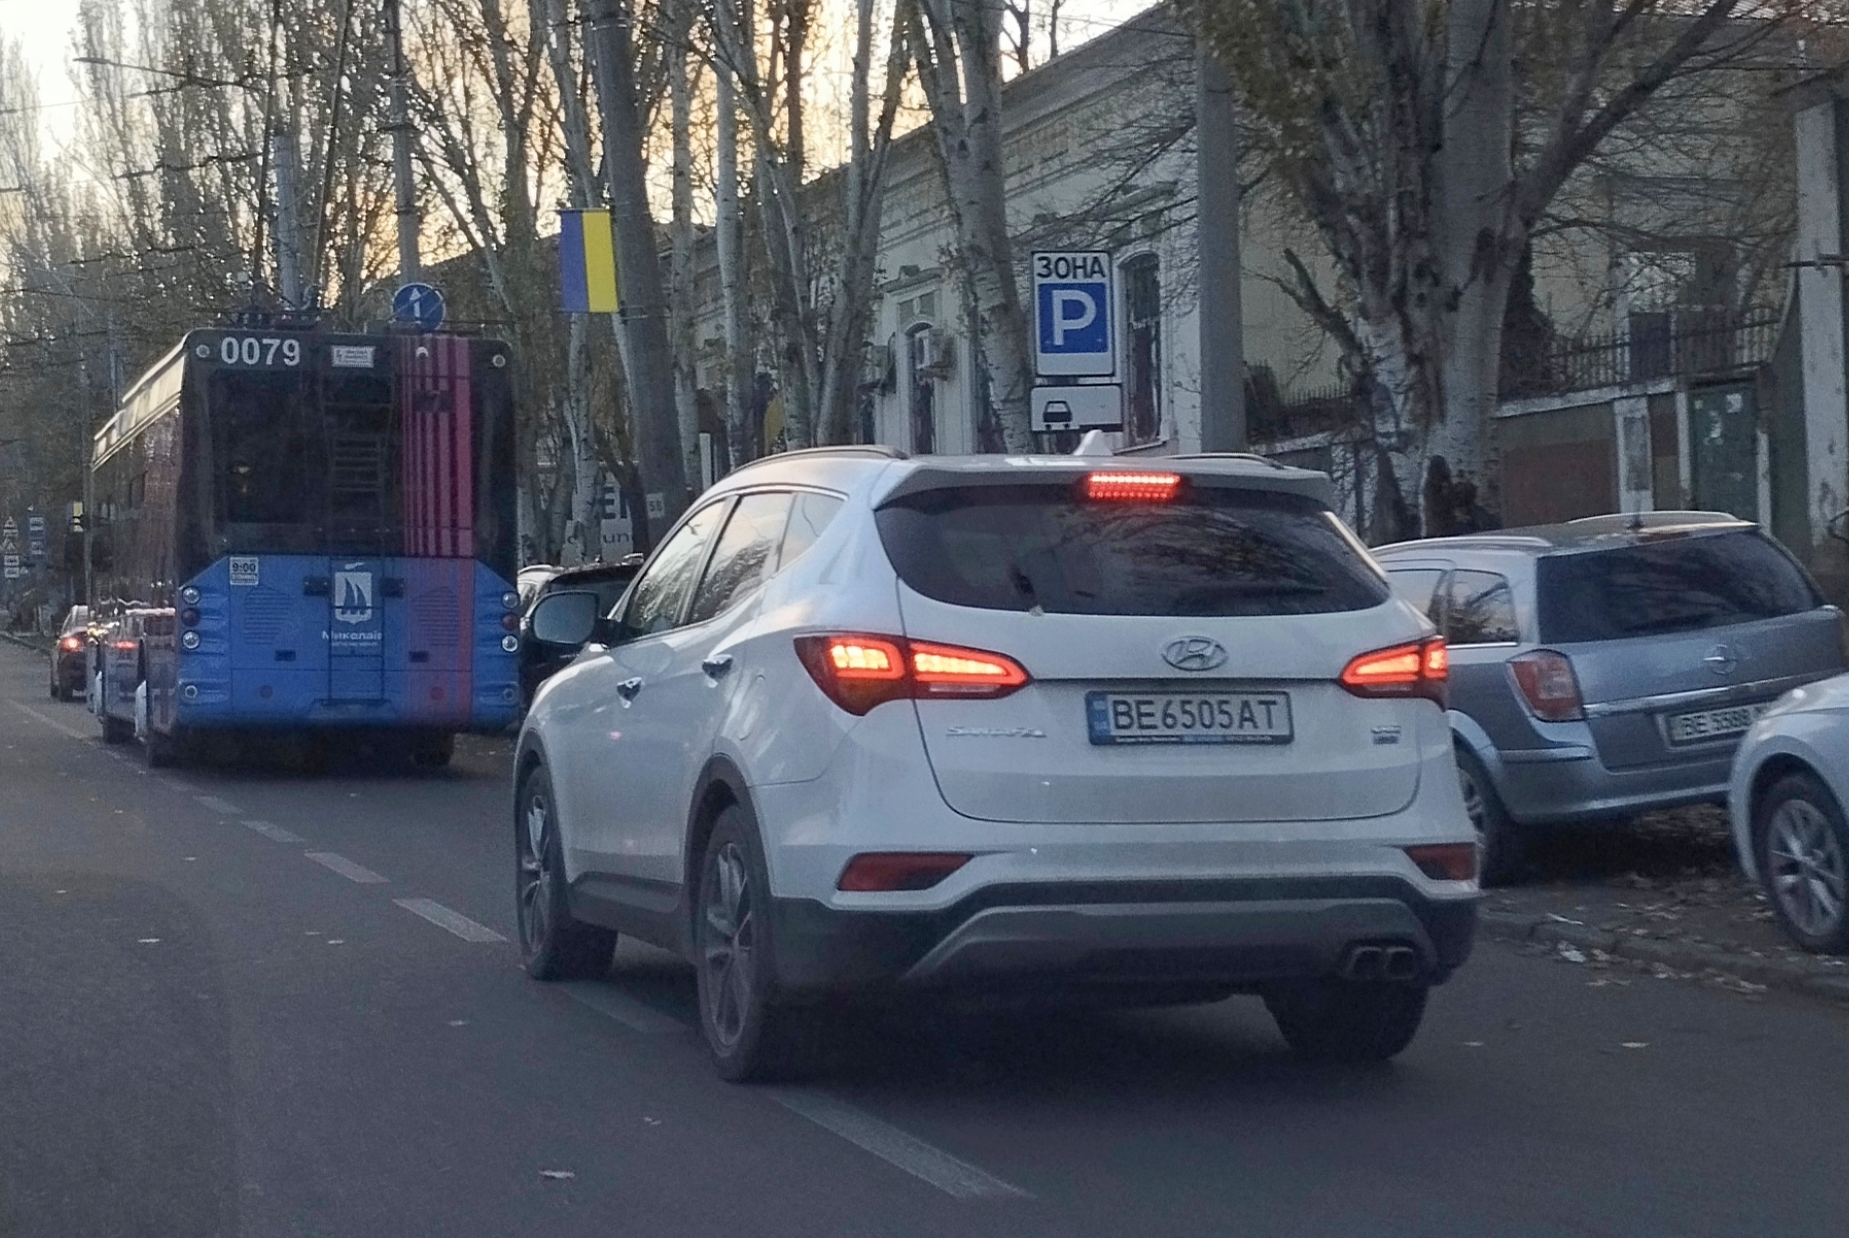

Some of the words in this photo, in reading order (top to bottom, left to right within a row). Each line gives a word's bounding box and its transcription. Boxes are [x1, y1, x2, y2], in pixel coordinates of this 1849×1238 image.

[1037, 256, 1106, 279] ЗОНА
[1052, 289, 1097, 346] P
[221, 337, 300, 365] 0079
[232, 562, 256, 573] 9:00
[1112, 700, 1278, 730] BE6505AT
